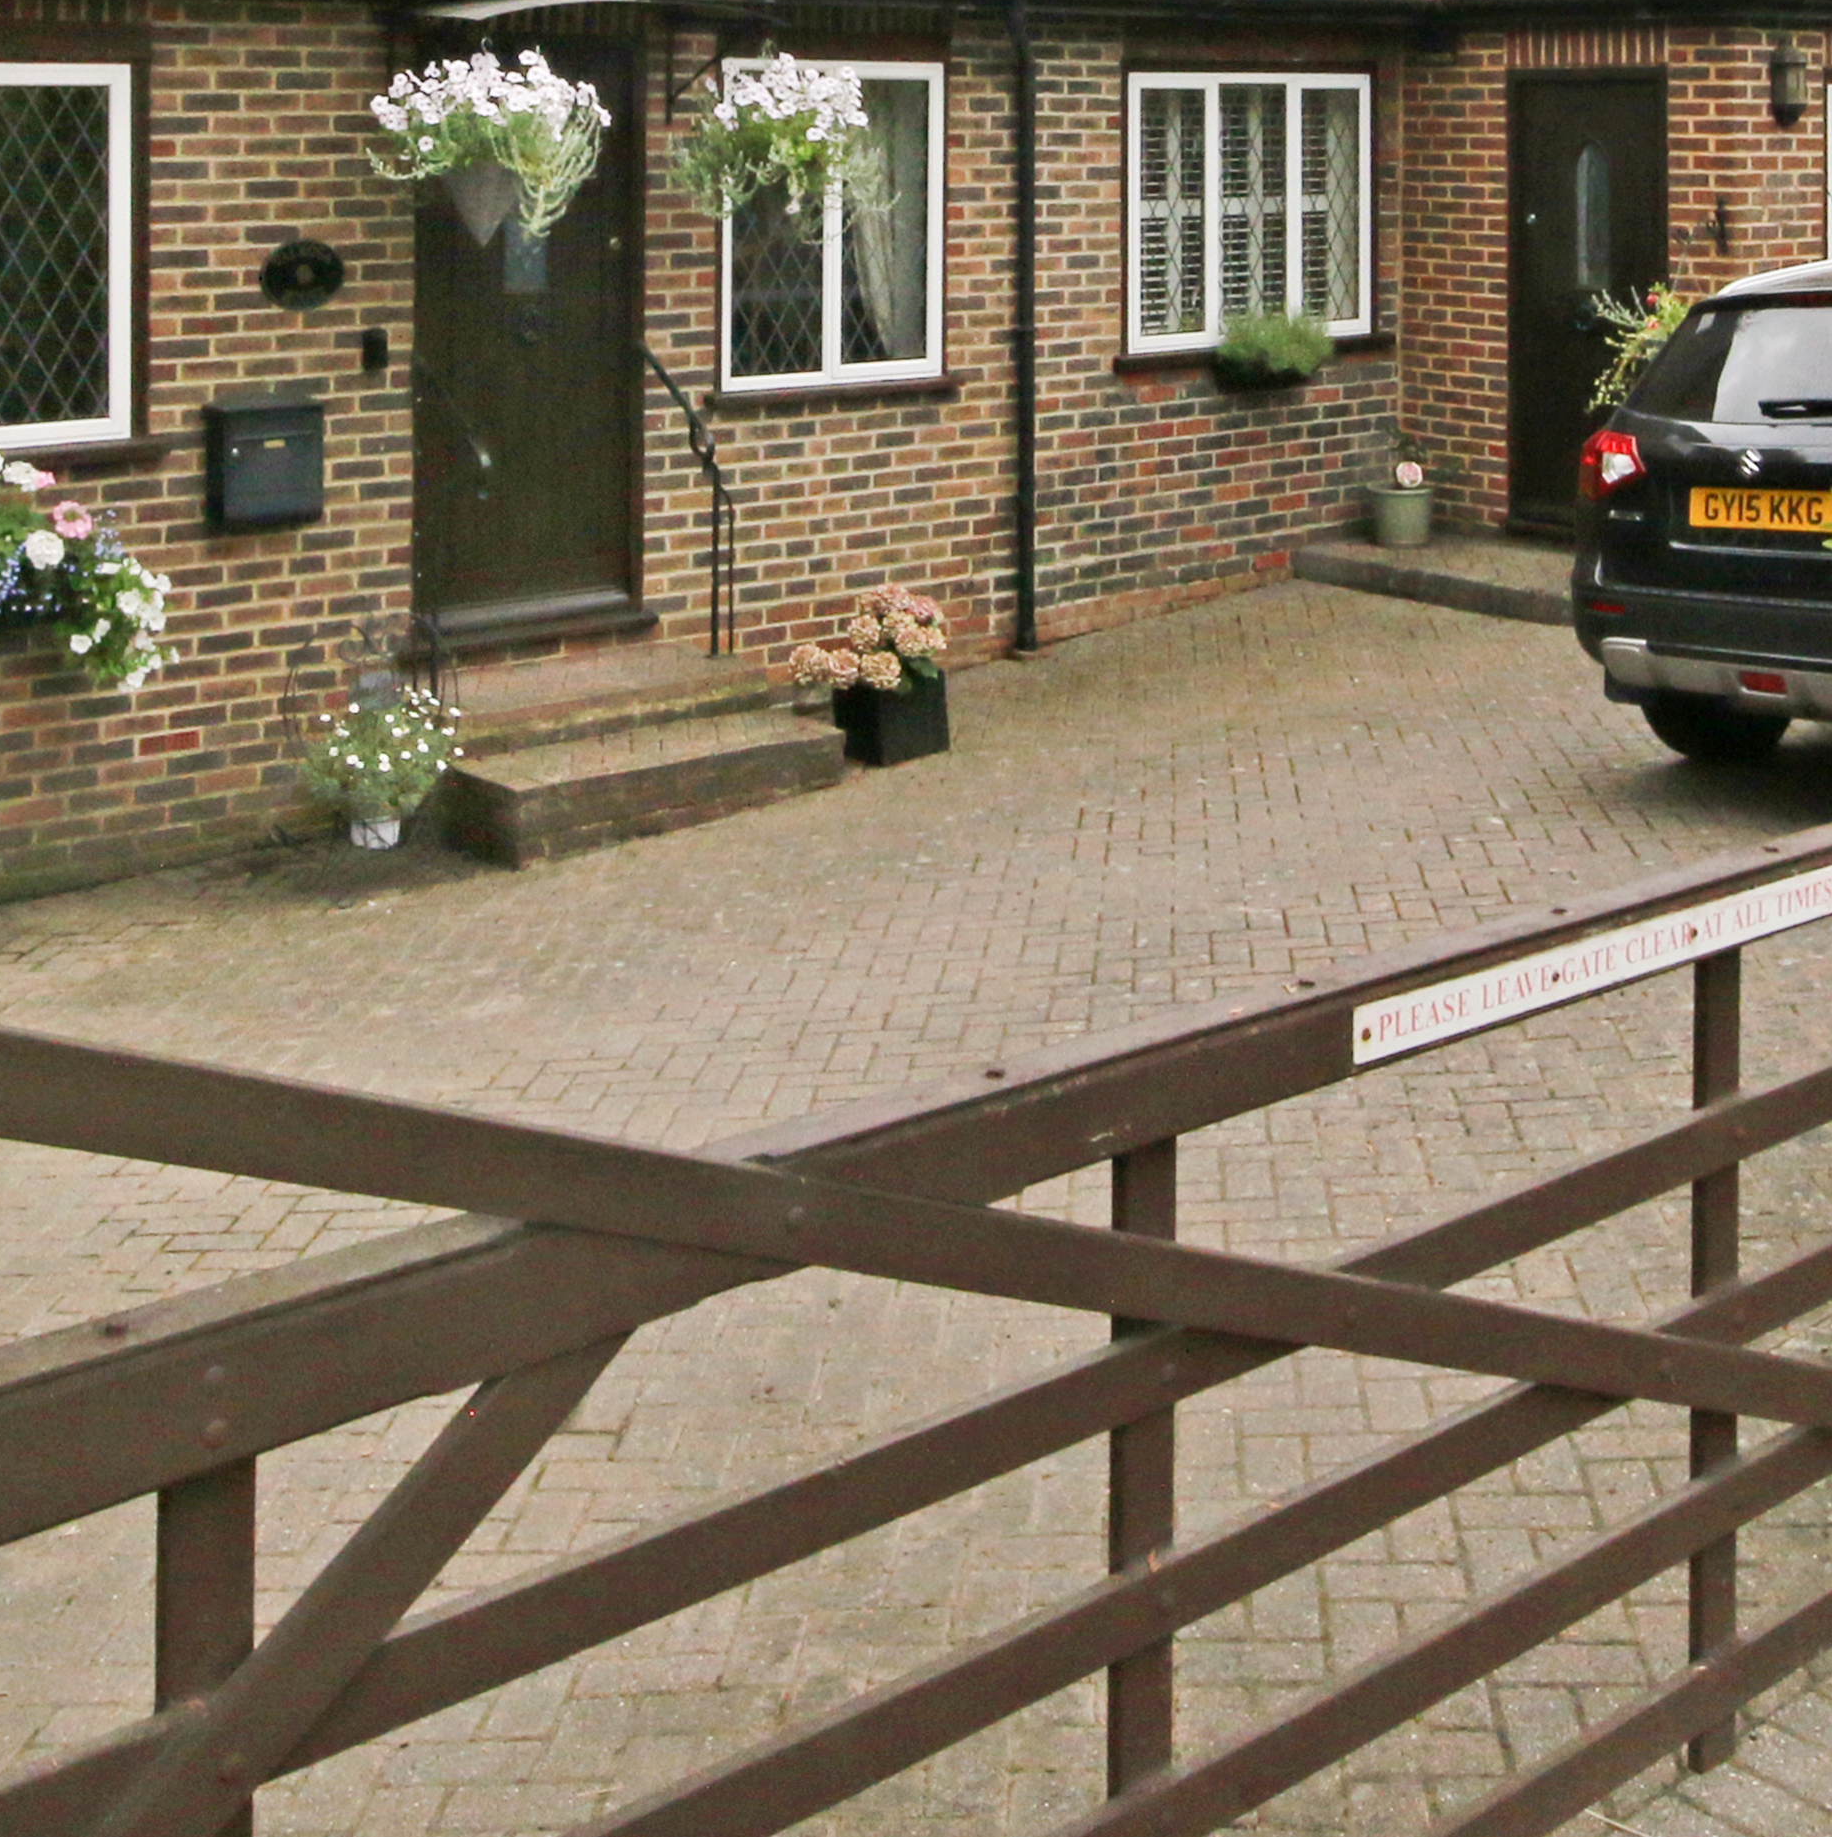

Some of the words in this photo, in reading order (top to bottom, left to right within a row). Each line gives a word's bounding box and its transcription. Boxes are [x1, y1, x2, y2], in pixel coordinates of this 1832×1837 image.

[1704, 493, 1761, 523] GY15
[1769, 494, 1824, 525] KKG
[1378, 994, 1470, 1042] PLEASE
[1481, 963, 1553, 1010] LEAVE
[1561, 944, 1618, 986] GATE
[1626, 921, 1693, 963] CLEAR
[1698, 912, 1727, 941] AT
[1732, 899, 1769, 931] ALL
